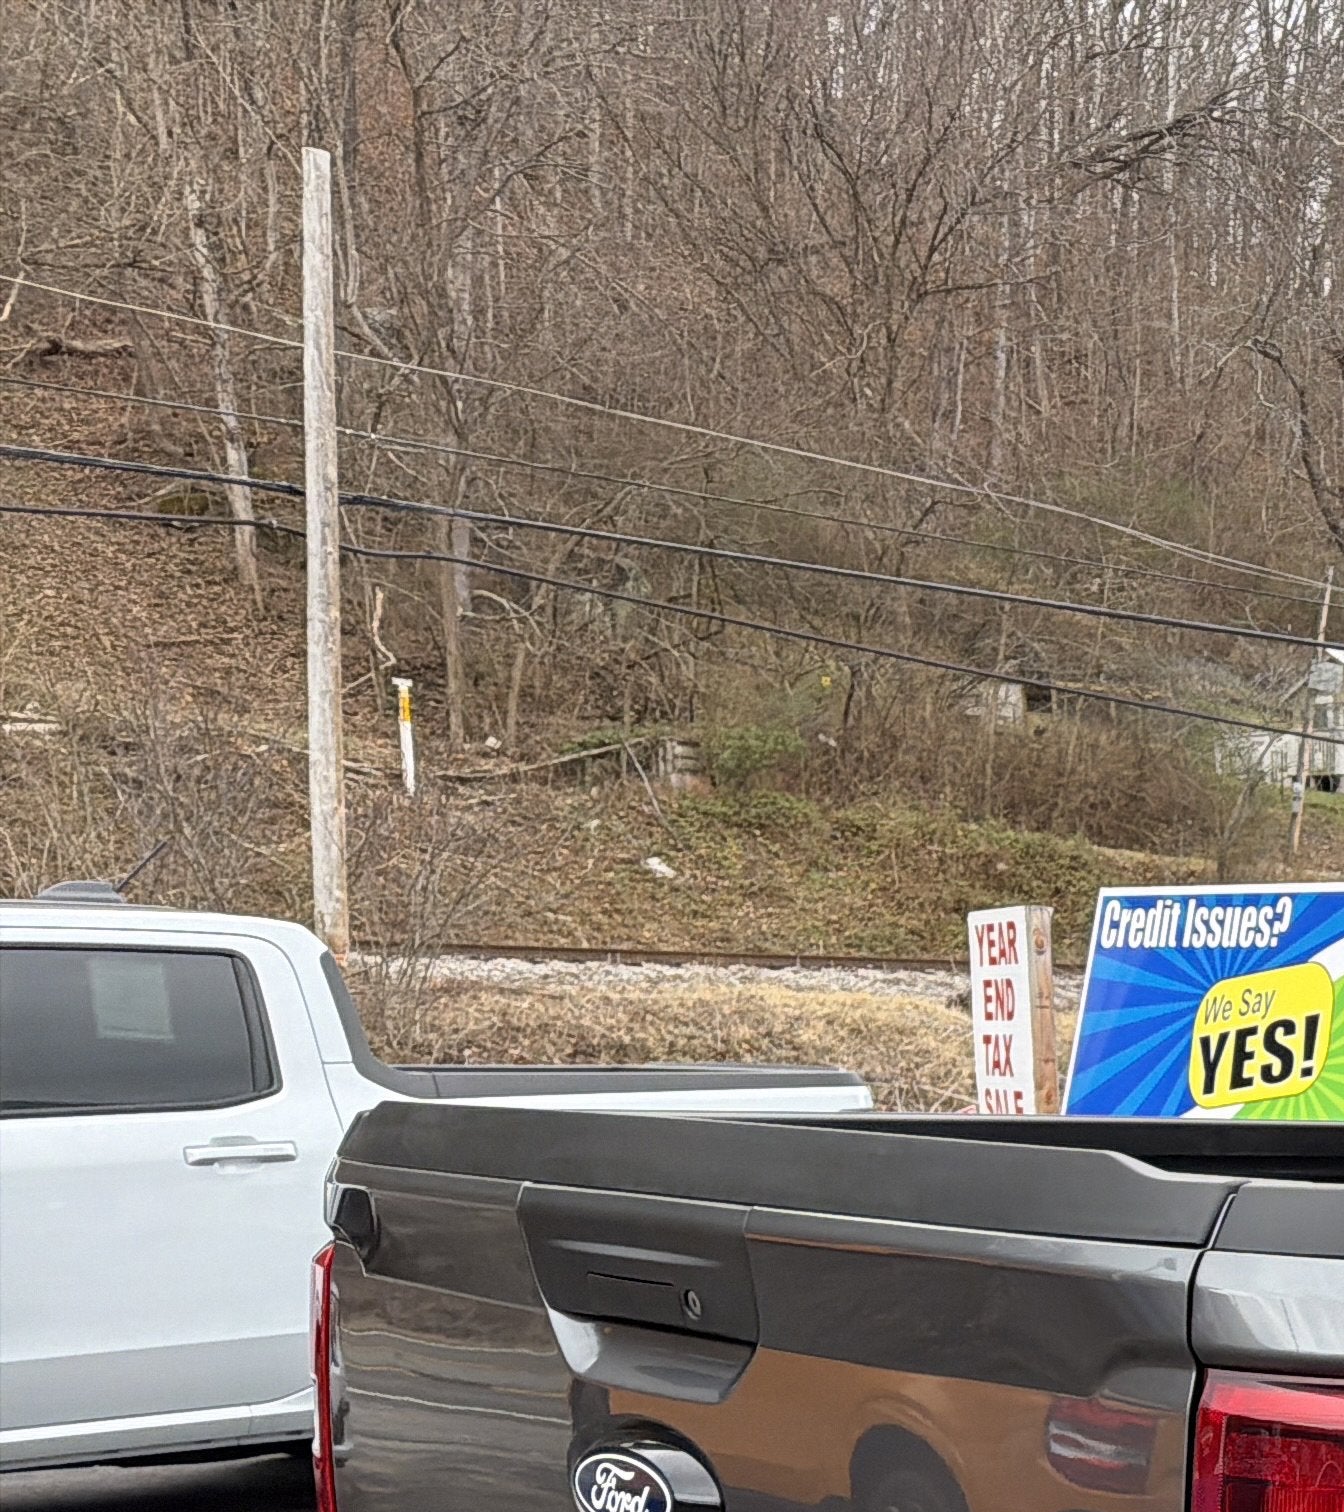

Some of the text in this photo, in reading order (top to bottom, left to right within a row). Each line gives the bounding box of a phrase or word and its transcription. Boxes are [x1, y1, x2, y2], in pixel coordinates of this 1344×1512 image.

[974, 921, 1019, 967] YEAR
[1100, 896, 1293, 949] Credit Issues?
[983, 978, 1015, 1021] END
[1204, 988, 1276, 1025] We Say
[983, 1034, 1014, 1077] TAX
[1199, 1013, 1321, 1096] YES!
